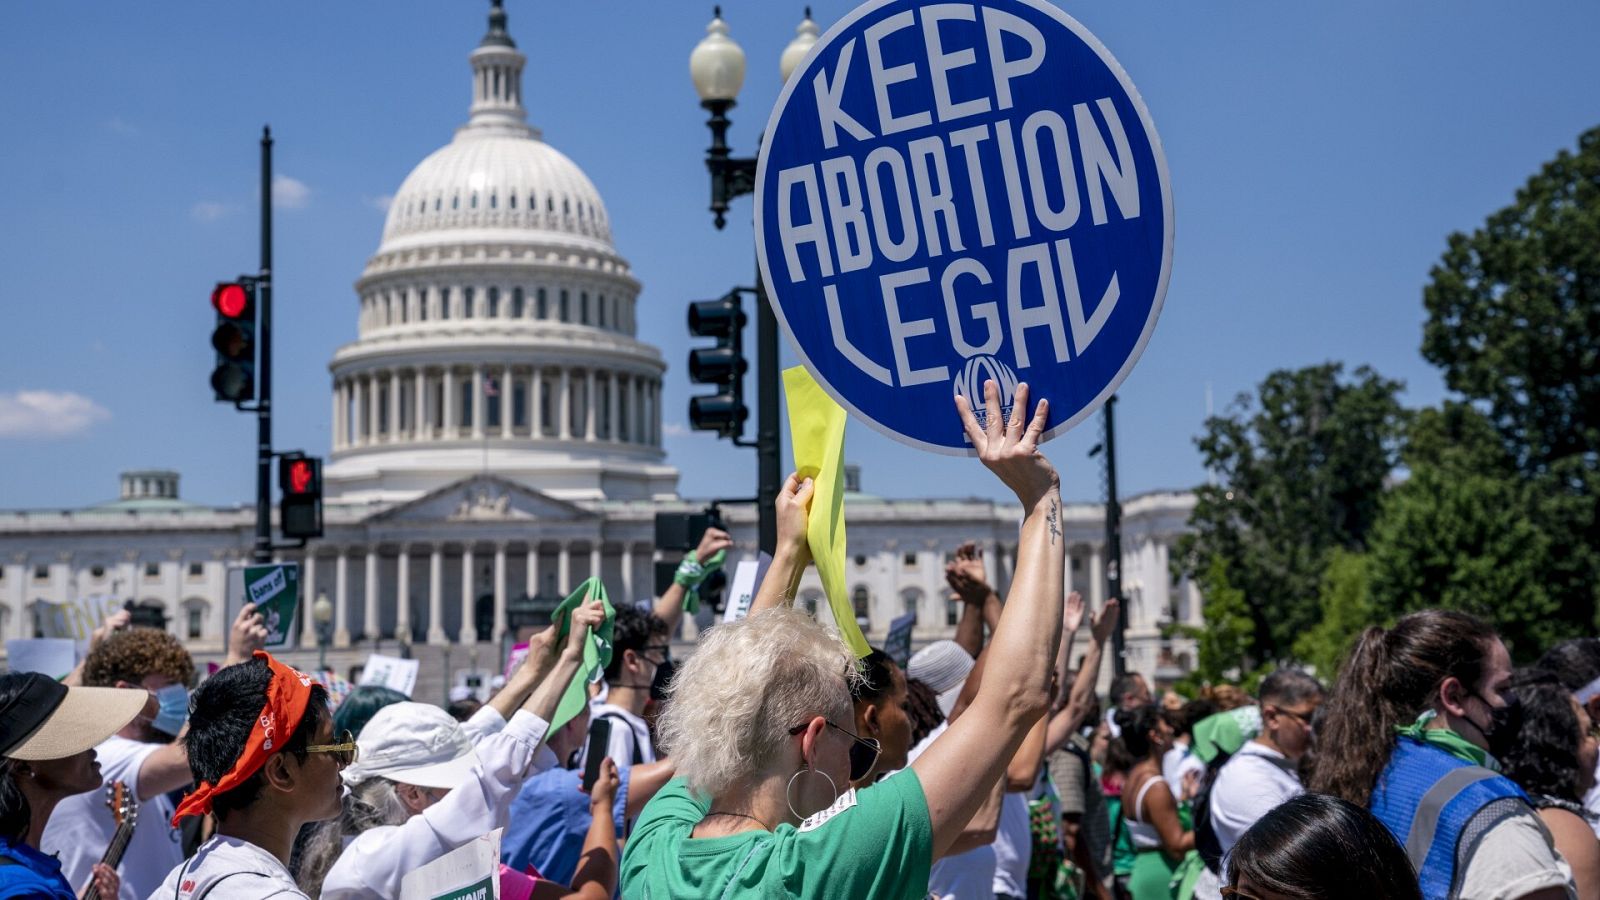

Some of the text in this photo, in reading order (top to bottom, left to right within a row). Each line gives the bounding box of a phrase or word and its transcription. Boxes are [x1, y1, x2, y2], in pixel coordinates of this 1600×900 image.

[813, 3, 1046, 149] KEEP
[778, 97, 1140, 283] ABORTION
[823, 238, 1121, 388] LEGAL
